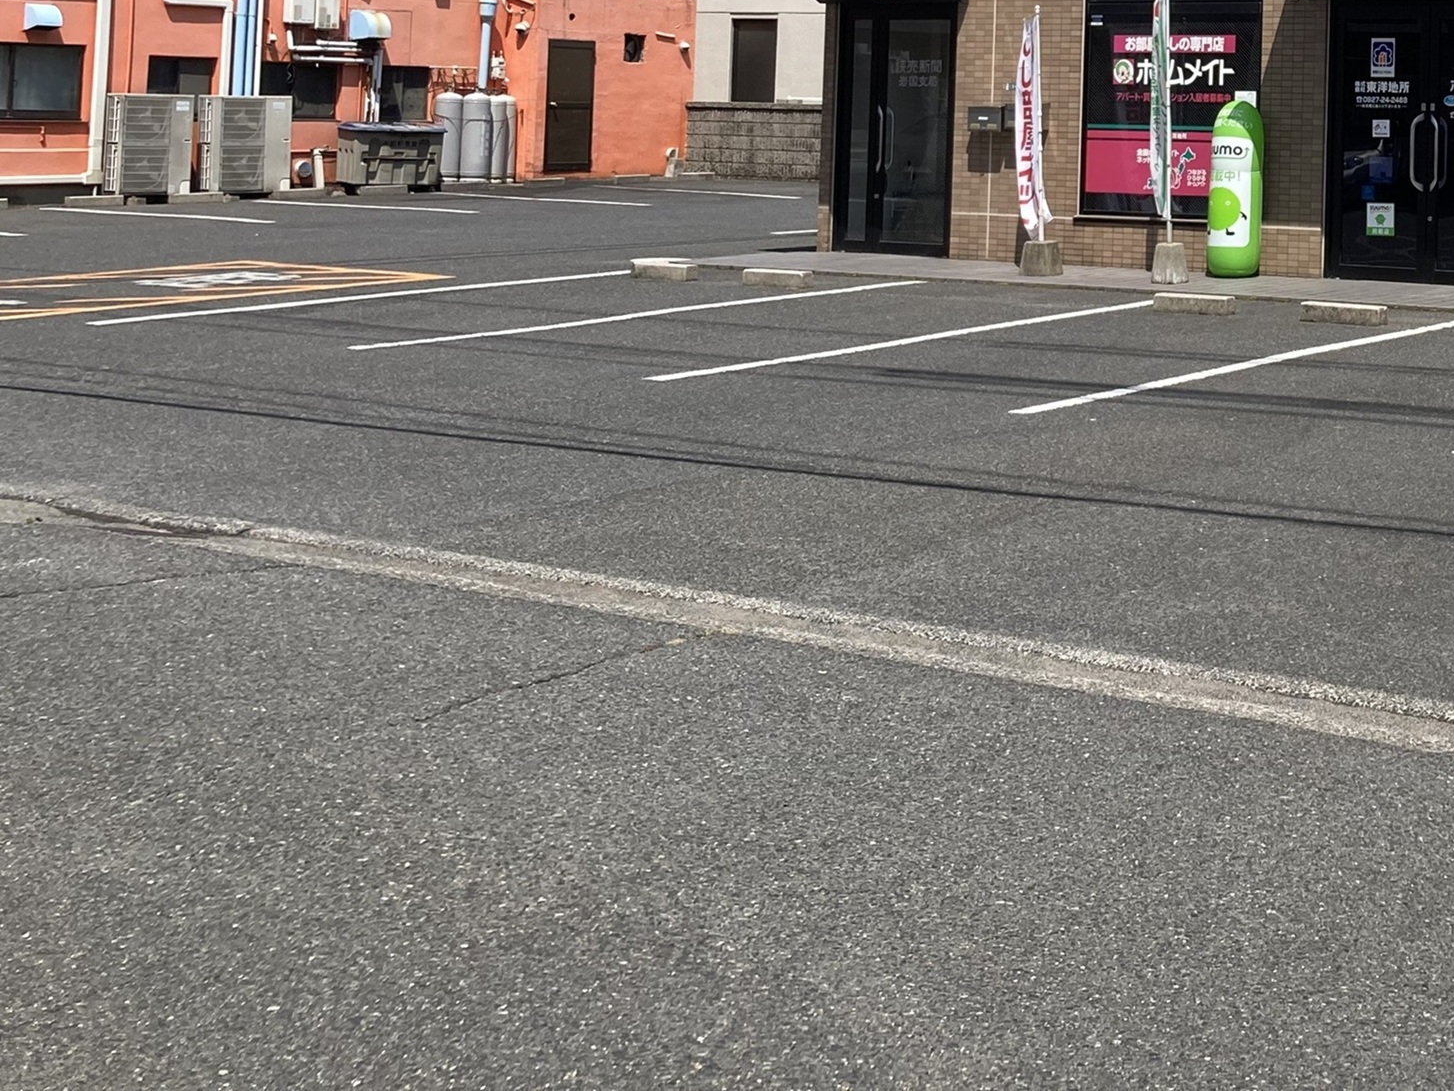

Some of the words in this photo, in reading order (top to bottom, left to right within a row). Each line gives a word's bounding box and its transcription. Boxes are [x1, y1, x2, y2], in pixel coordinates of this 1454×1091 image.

[1125, 37, 1225, 52] お部しの専門店
[1136, 58, 1235, 86] ホムメイト
